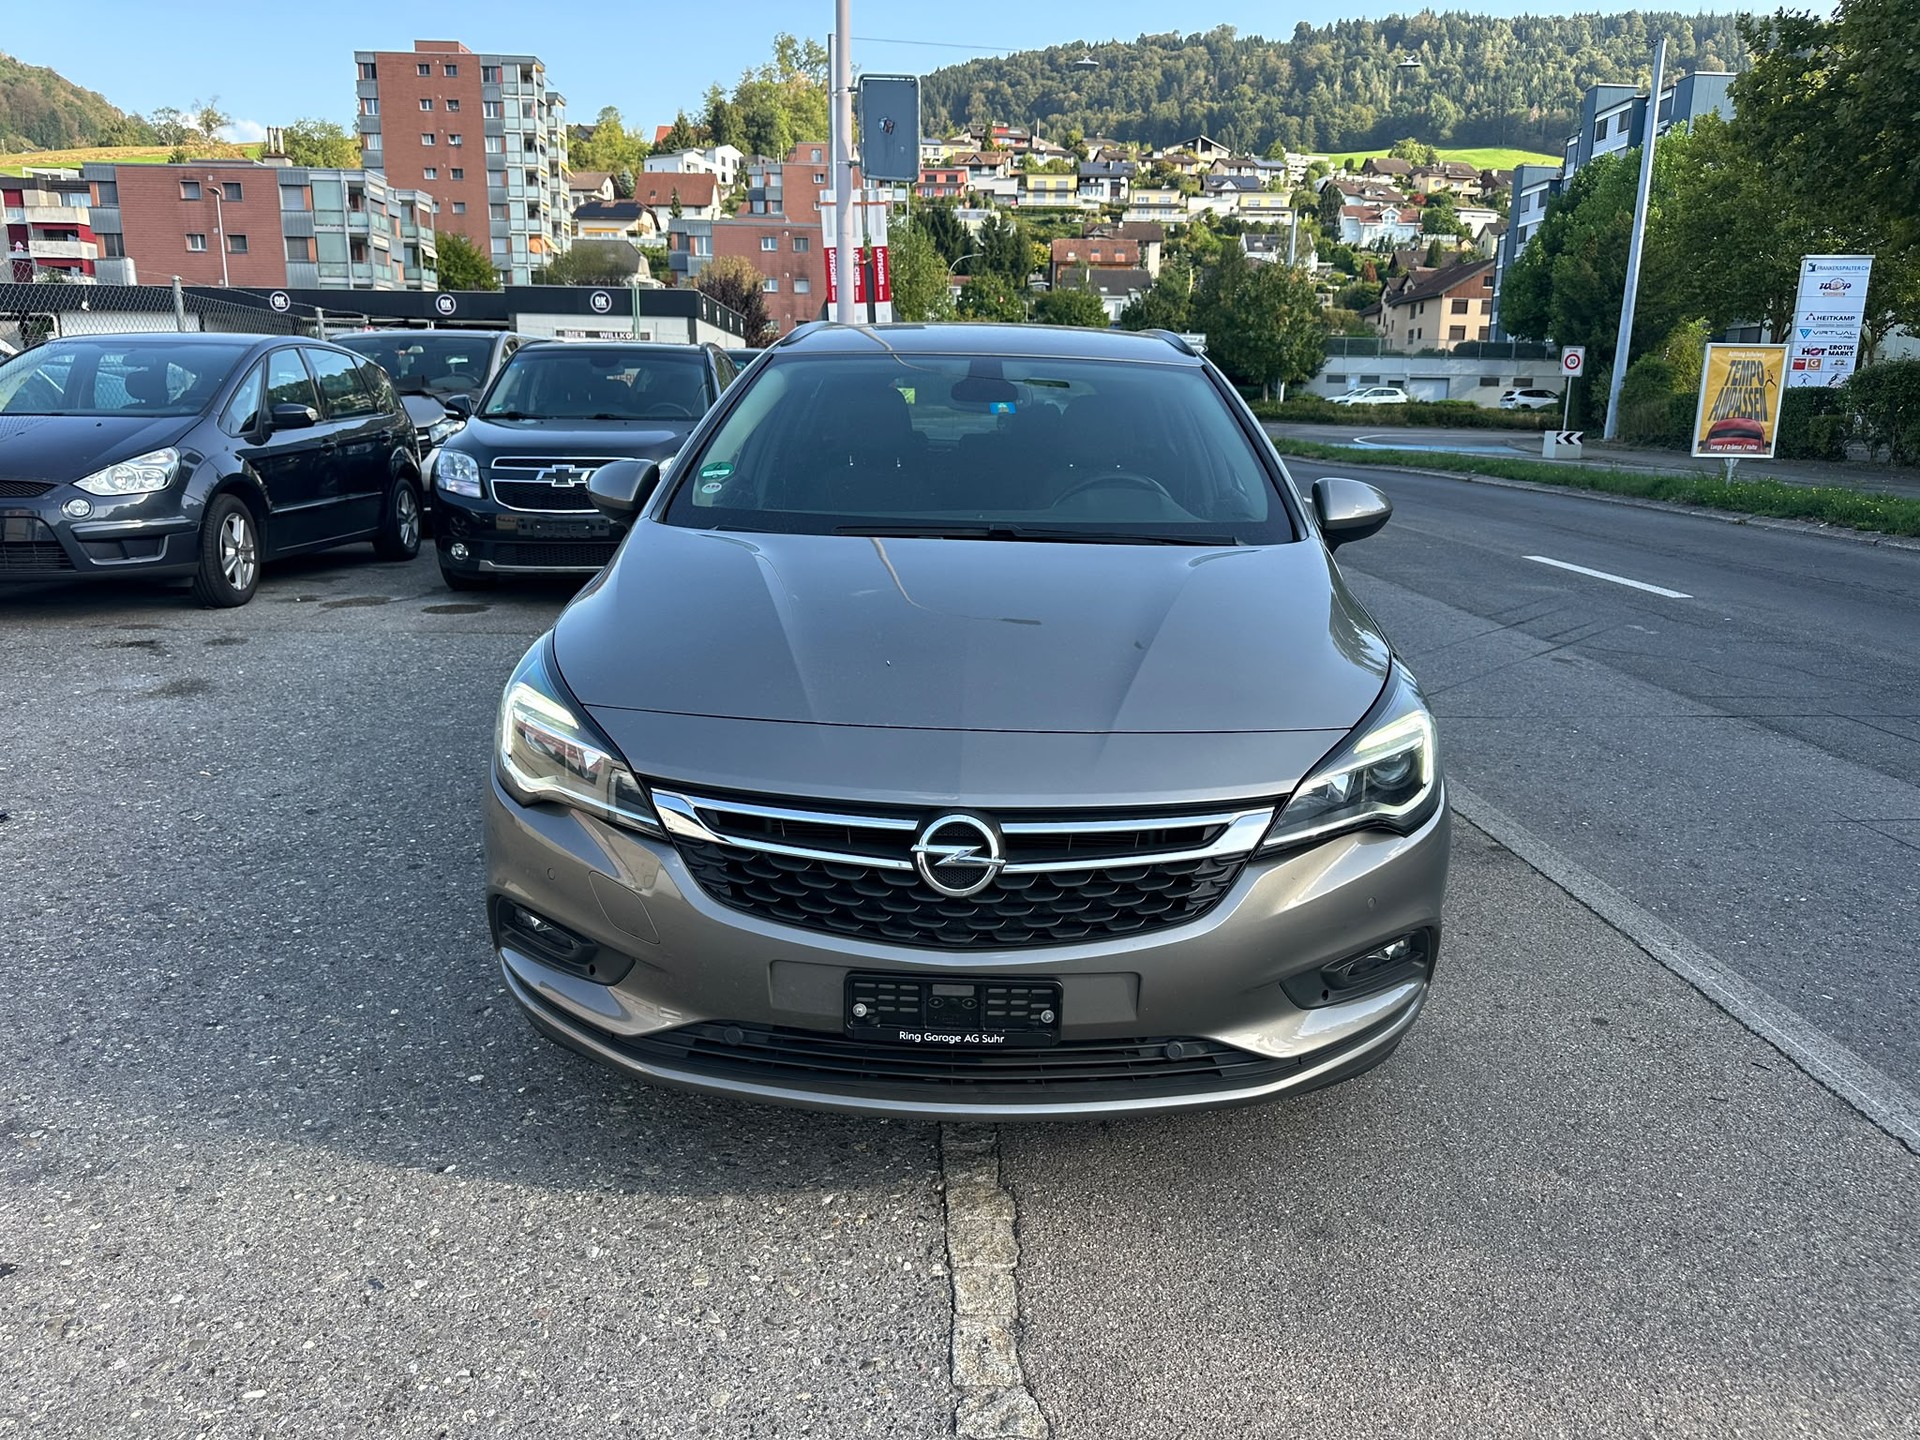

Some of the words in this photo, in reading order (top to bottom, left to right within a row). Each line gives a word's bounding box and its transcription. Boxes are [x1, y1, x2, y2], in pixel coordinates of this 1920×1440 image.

[274, 296, 286, 305] OK
[440, 298, 452, 308] OK
[595, 296, 606, 306] OK
[1802, 348, 1827, 356] HOT
[1724, 360, 1764, 386] TEMPO
[1708, 387, 1768, 421] ANPASSEN
[899, 1031, 922, 1042] Ring
[923, 1032, 962, 1044] Garage
[964, 1034, 980, 1043] AG
[982, 1034, 1005, 1044] Suhr
